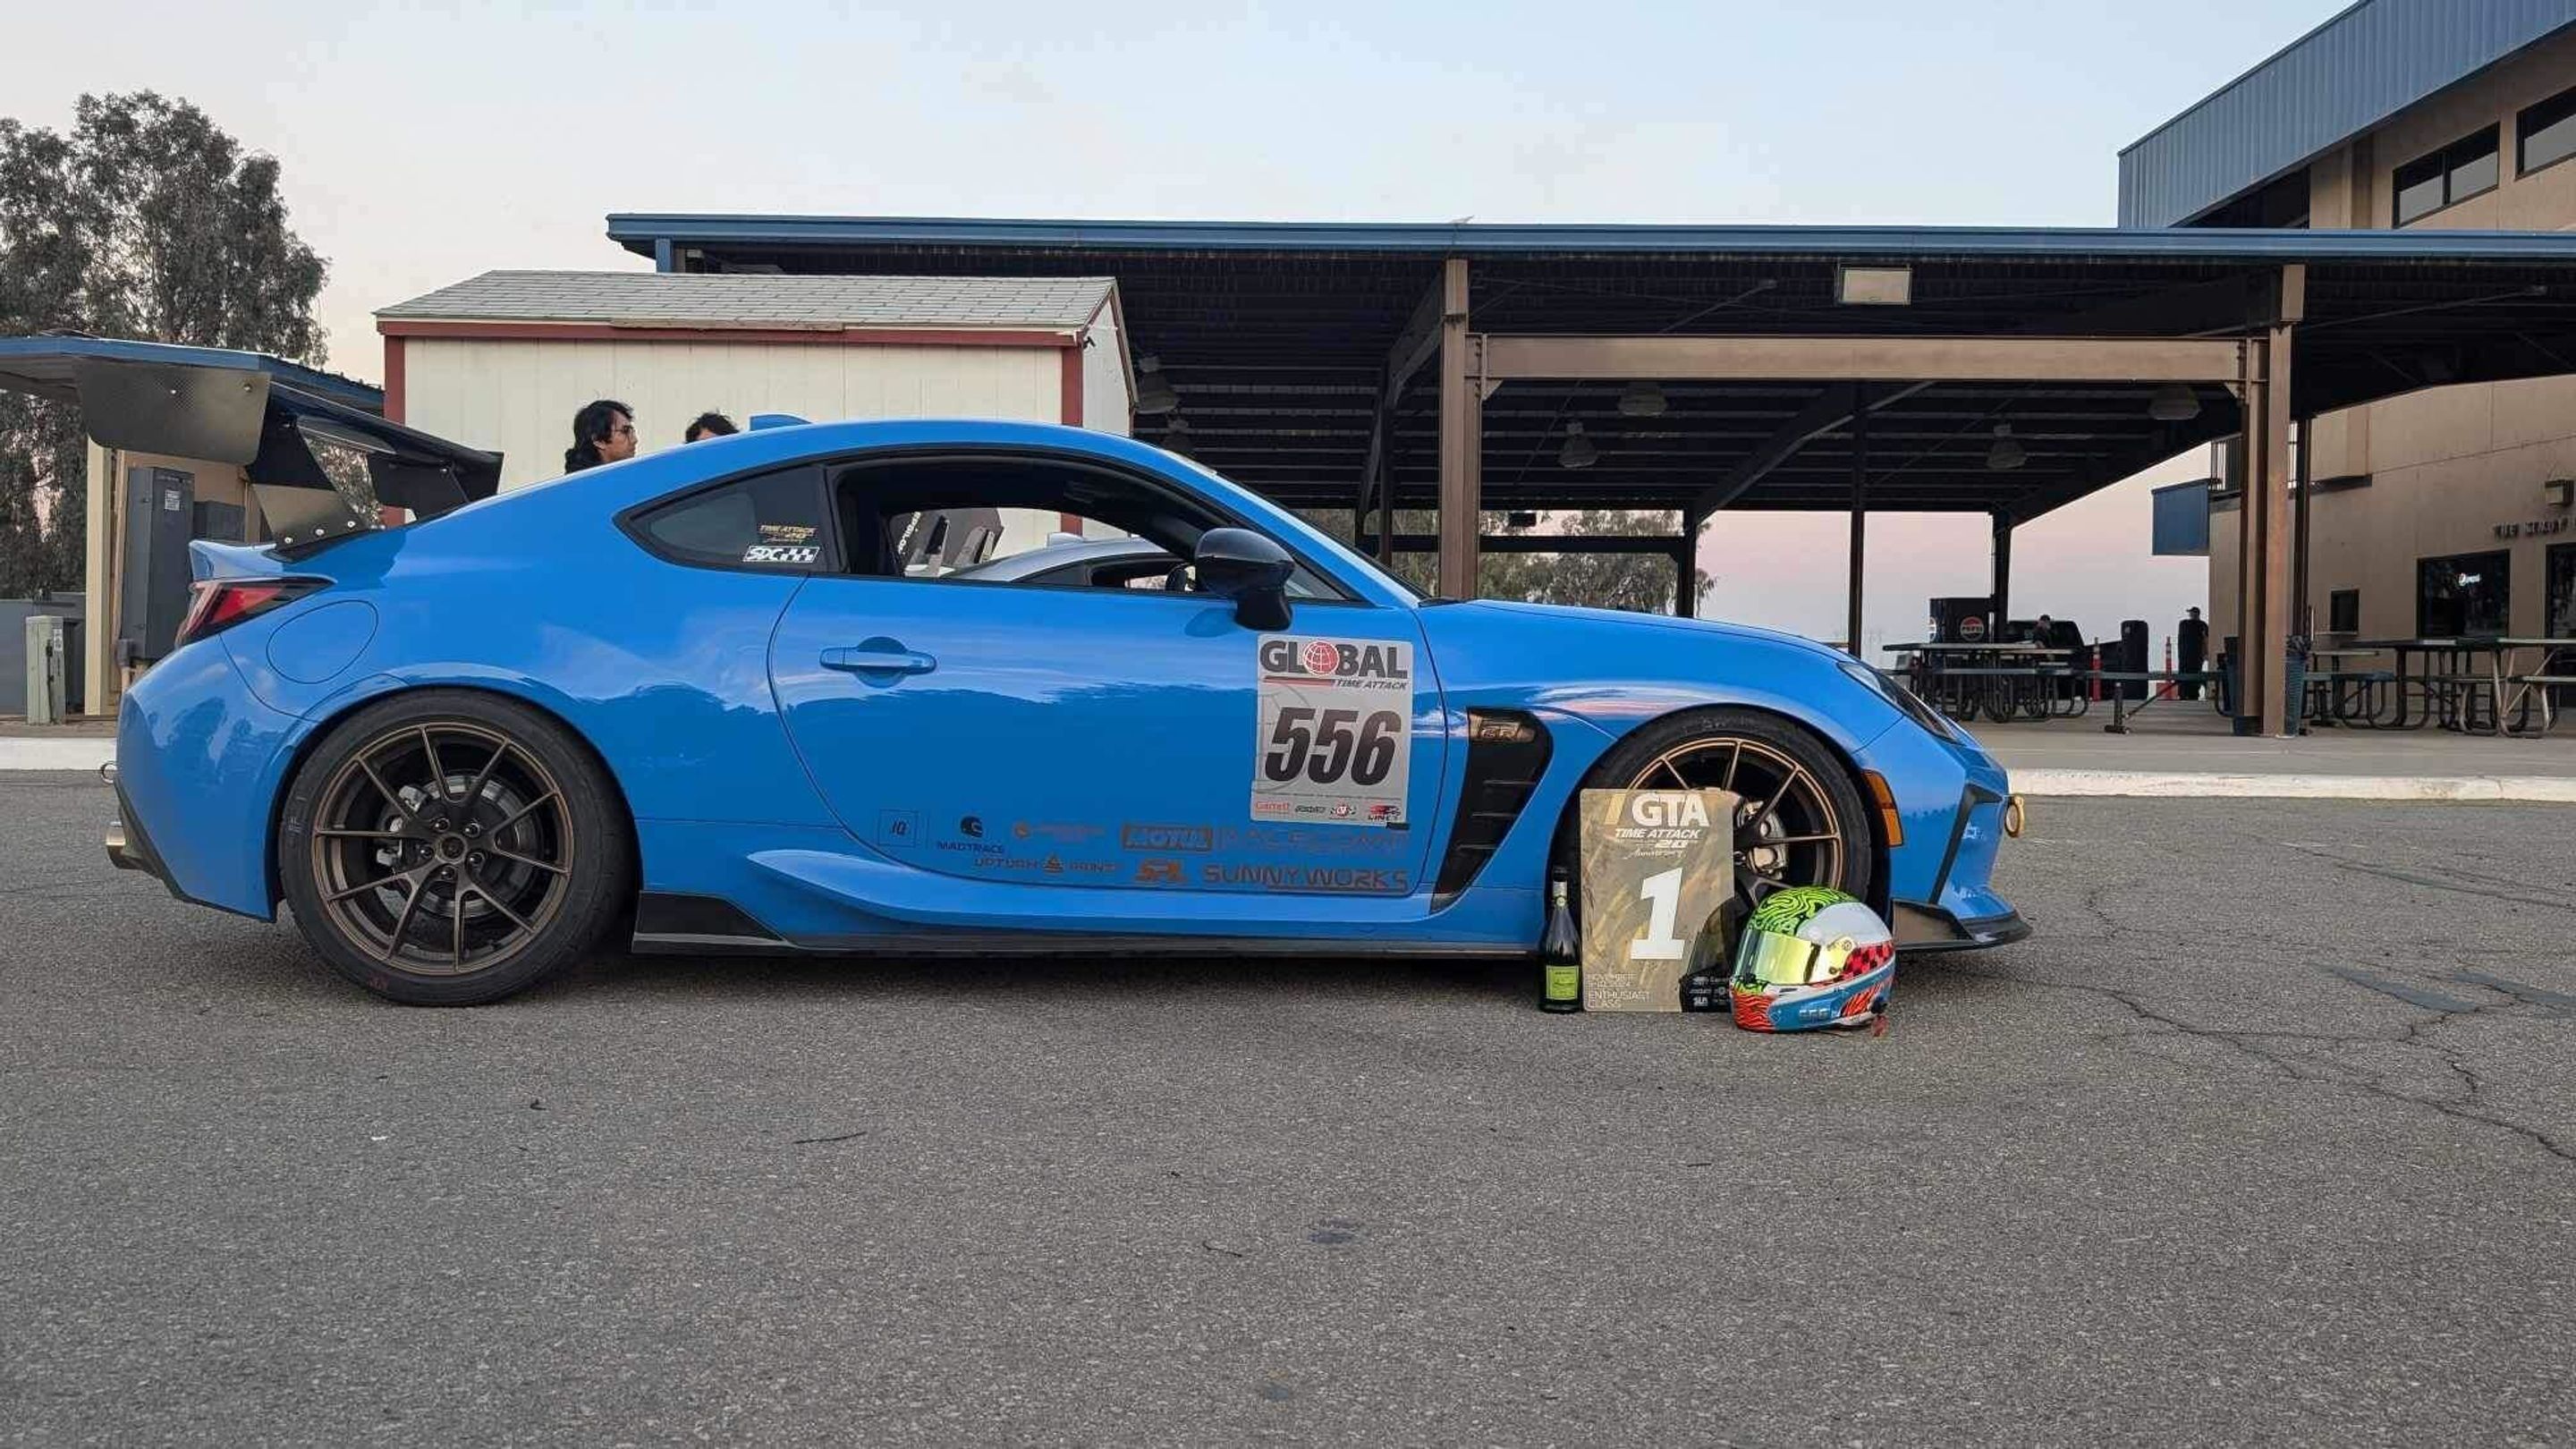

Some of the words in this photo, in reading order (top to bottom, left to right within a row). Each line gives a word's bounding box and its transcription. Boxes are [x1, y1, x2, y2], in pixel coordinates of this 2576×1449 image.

[1336, 679, 1362, 689] TIME
[1363, 680, 1408, 691] ATTACK
[1265, 707, 1402, 786] 556
[1631, 792, 1710, 827] GTA
[1614, 827, 1646, 838] TIME
[1648, 828, 1701, 839] ATTACK
[1630, 867, 1685, 960] 1
